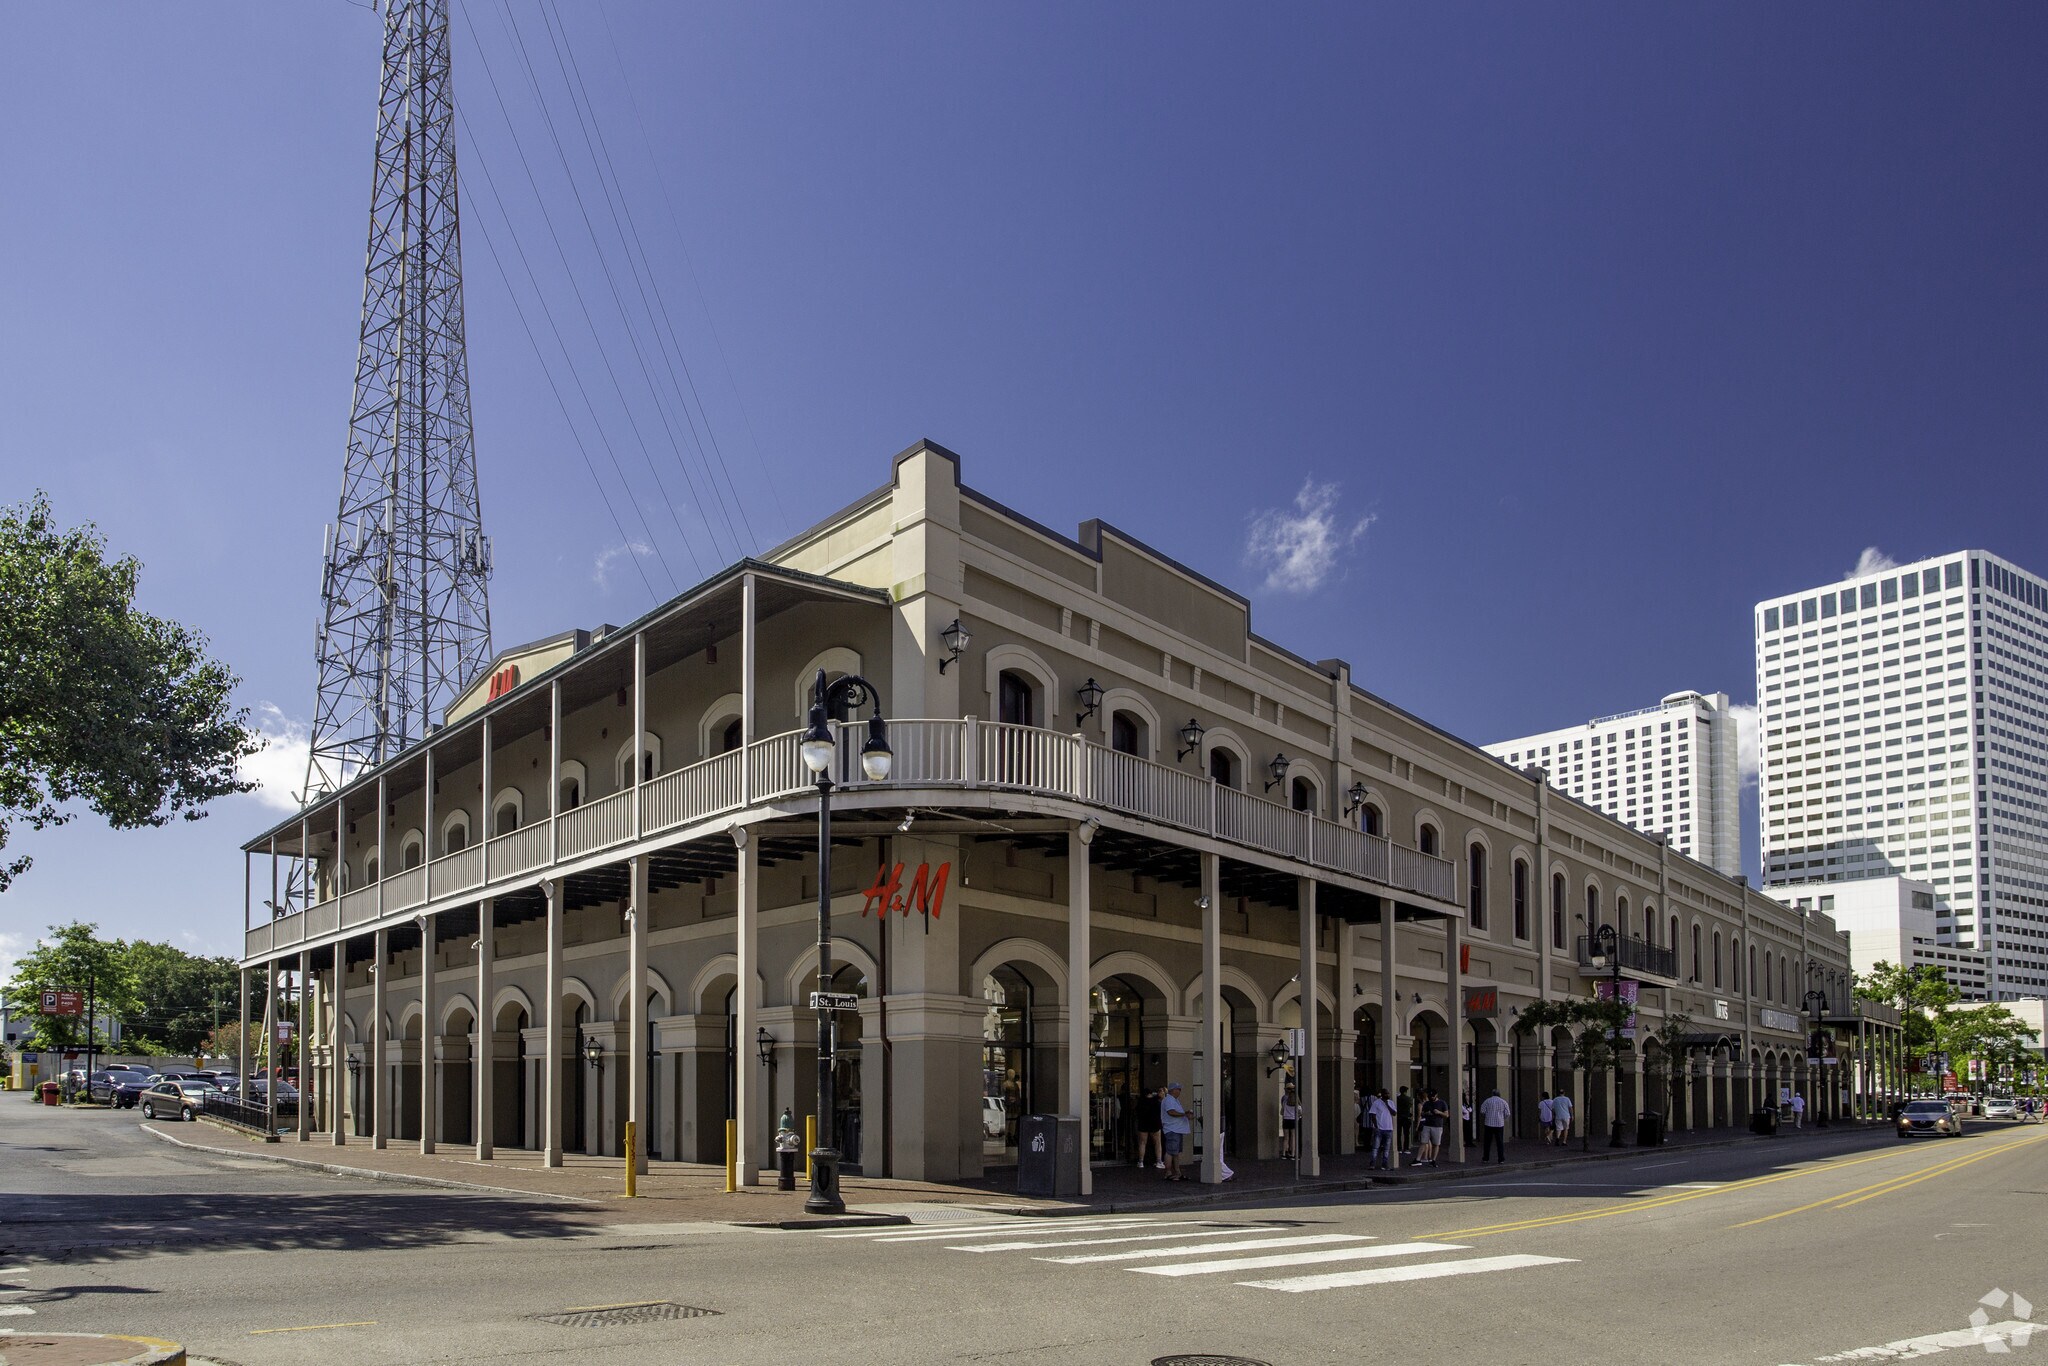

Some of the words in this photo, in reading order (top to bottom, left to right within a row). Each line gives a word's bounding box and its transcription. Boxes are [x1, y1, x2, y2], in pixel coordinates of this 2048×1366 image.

[862, 861, 951, 920] H&M
[818, 997, 832, 1007] St.
[835, 998, 857, 1008] Louis
[1714, 999, 1729, 1021] VANS
